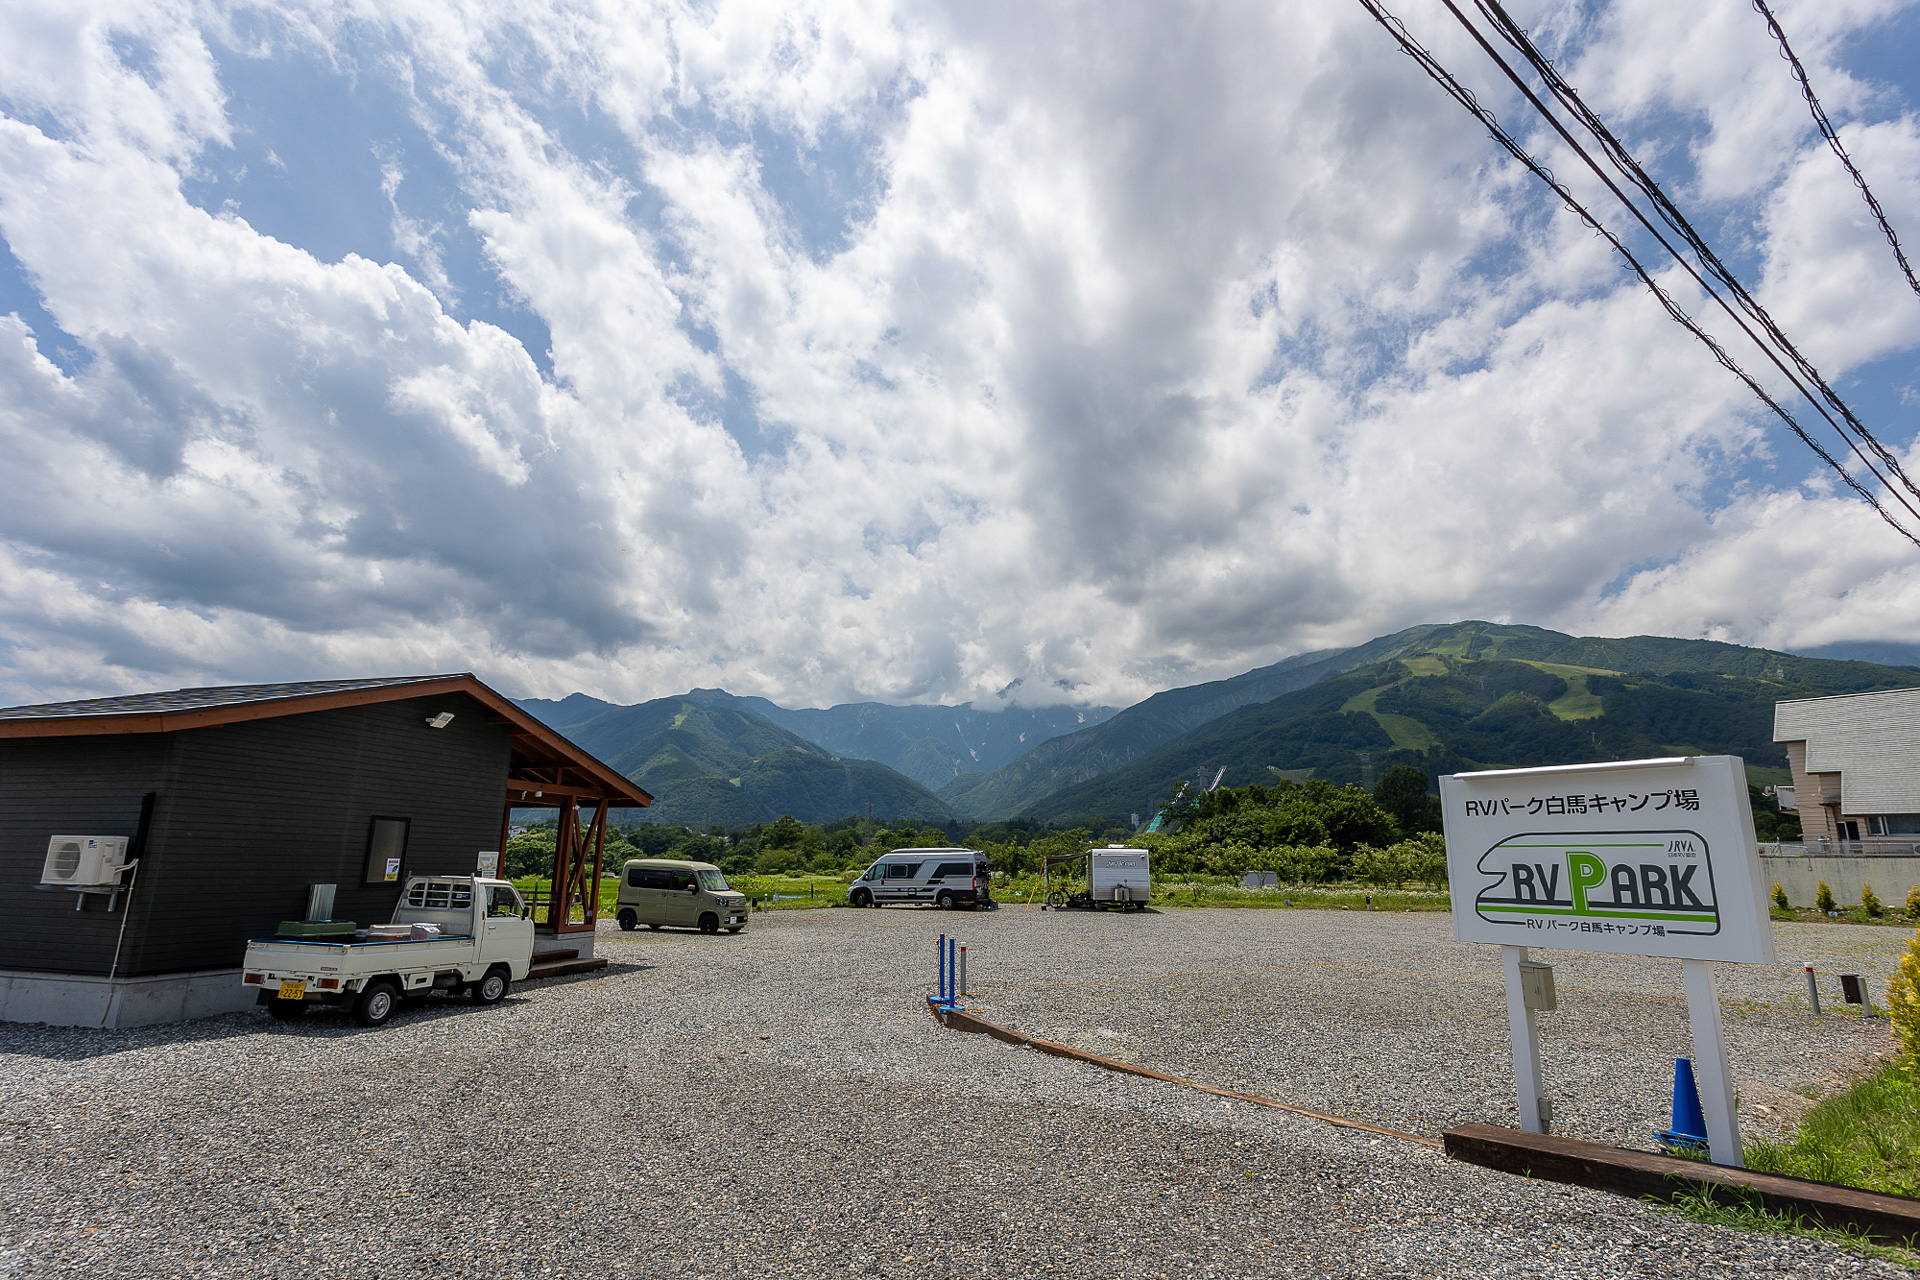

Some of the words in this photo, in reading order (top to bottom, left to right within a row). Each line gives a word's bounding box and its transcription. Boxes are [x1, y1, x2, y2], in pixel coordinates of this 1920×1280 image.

[1465, 789, 1700, 817] RVパーク白馬キャンプ場
